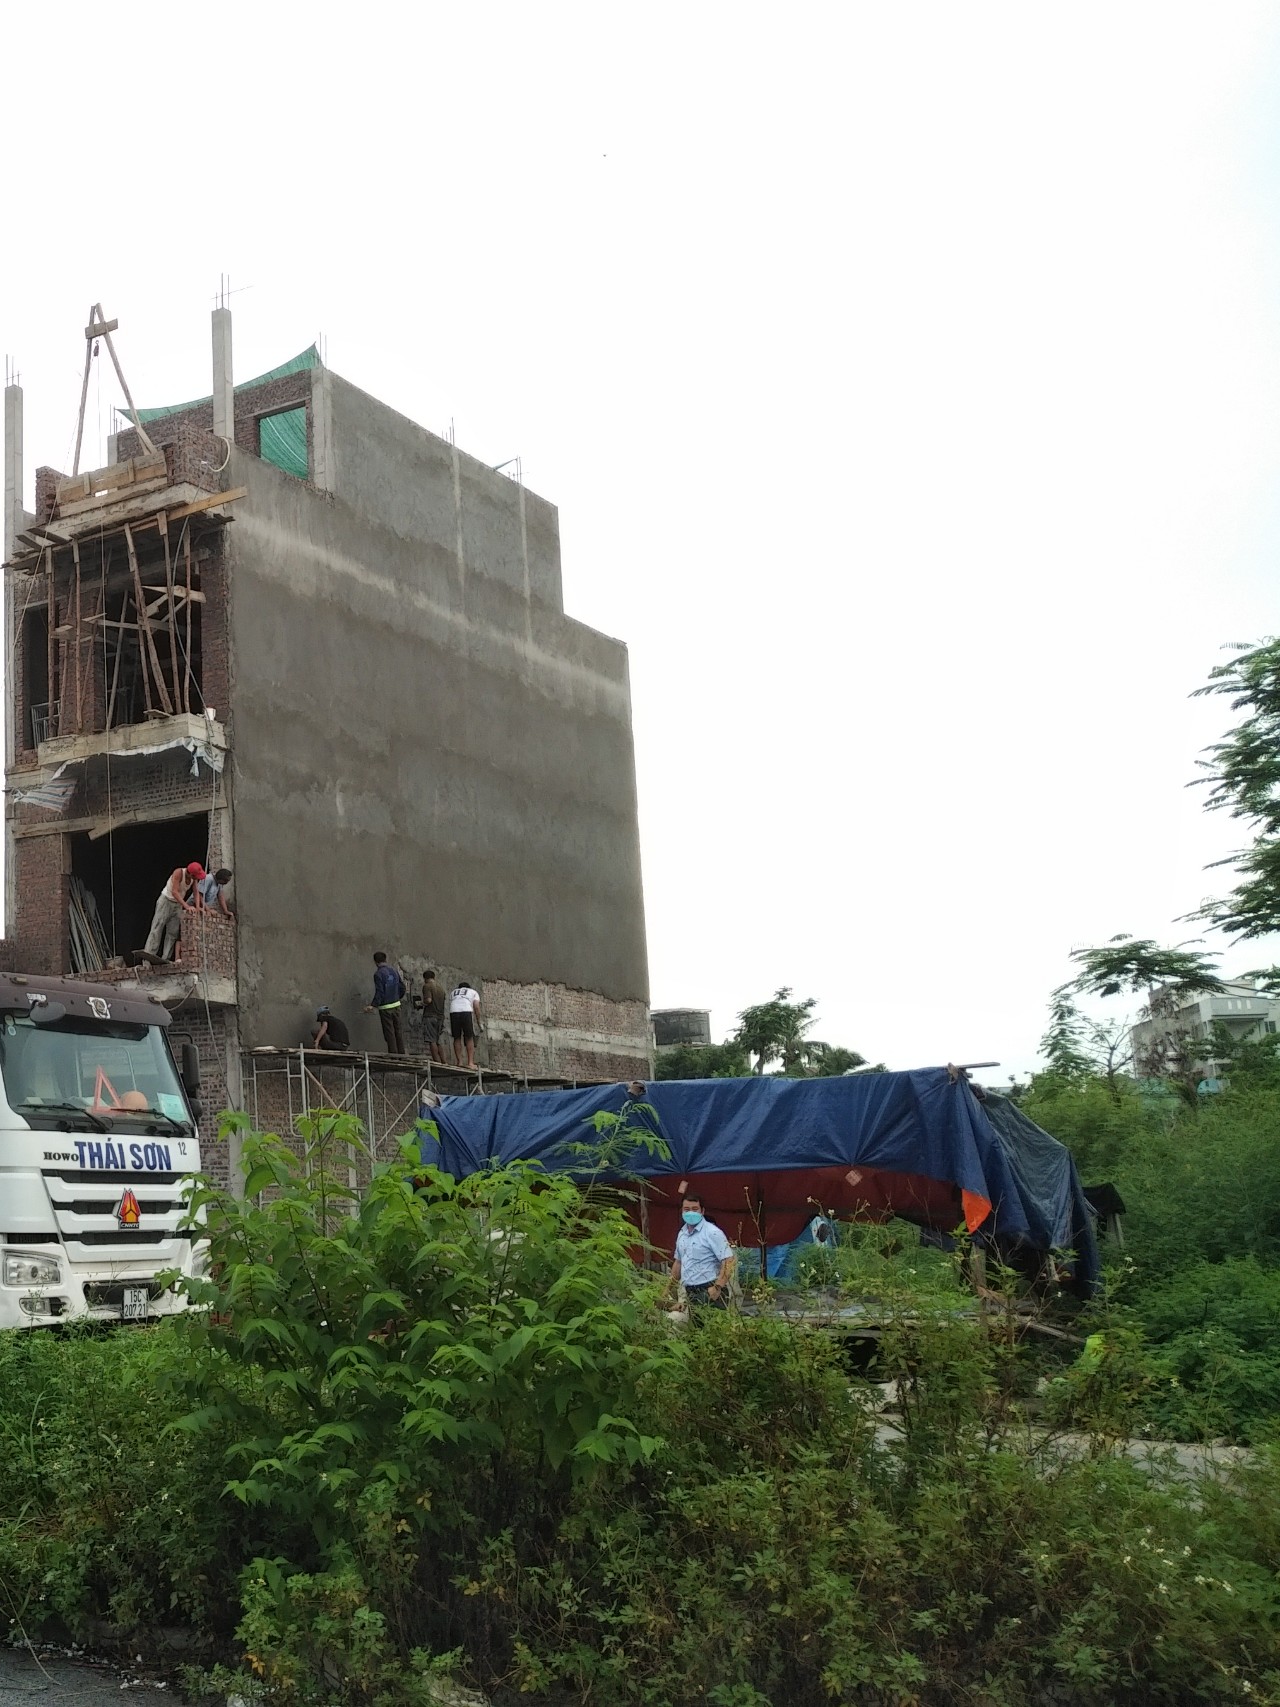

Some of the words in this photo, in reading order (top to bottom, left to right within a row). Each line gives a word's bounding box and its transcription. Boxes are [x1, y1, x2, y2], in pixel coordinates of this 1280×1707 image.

[74, 1137, 126, 1170] THÁI
[129, 1142, 172, 1171] SƠN
[177, 1141, 188, 1156] 12
[43, 1151, 79, 1162] HOWO
[130, 1290, 142, 1303] 15C
[124, 1303, 146, 1317] 207.21
